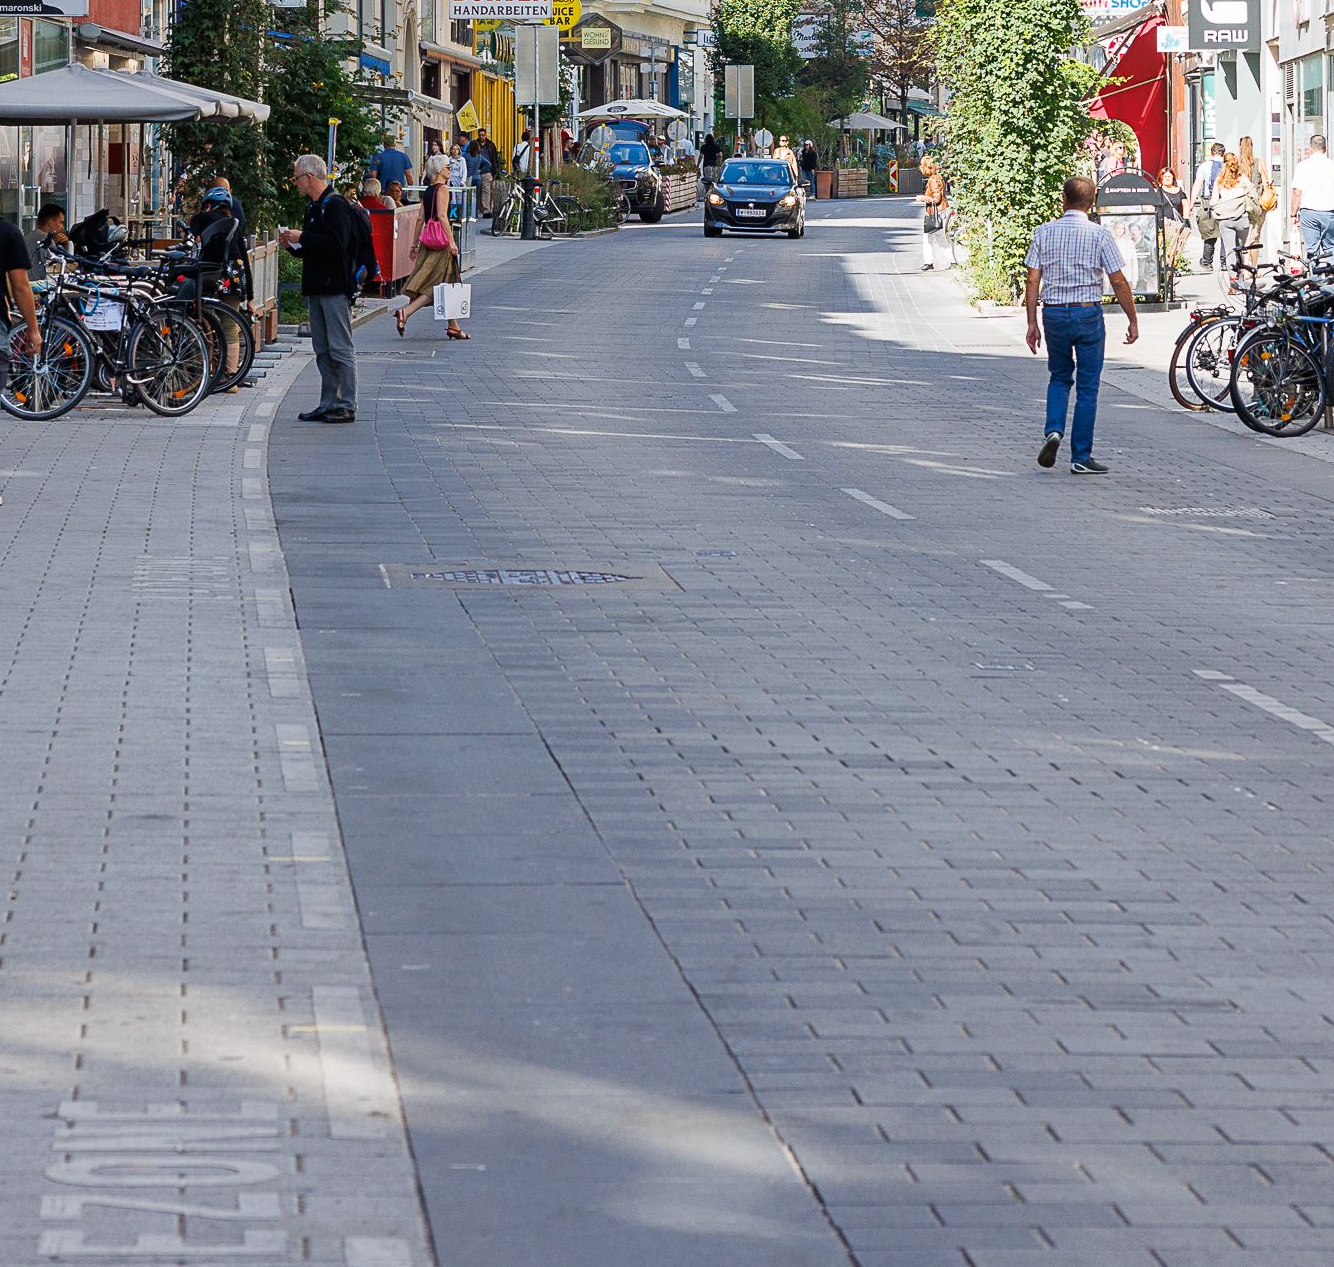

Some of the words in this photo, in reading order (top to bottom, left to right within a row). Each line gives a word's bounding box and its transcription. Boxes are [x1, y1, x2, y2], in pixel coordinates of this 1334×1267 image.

[0, 4, 42, 13] maronski
[454, 6, 548, 17] HANDARBEITEN
[549, 17, 571, 25] BAR
[1203, 29, 1249, 44] RAW
